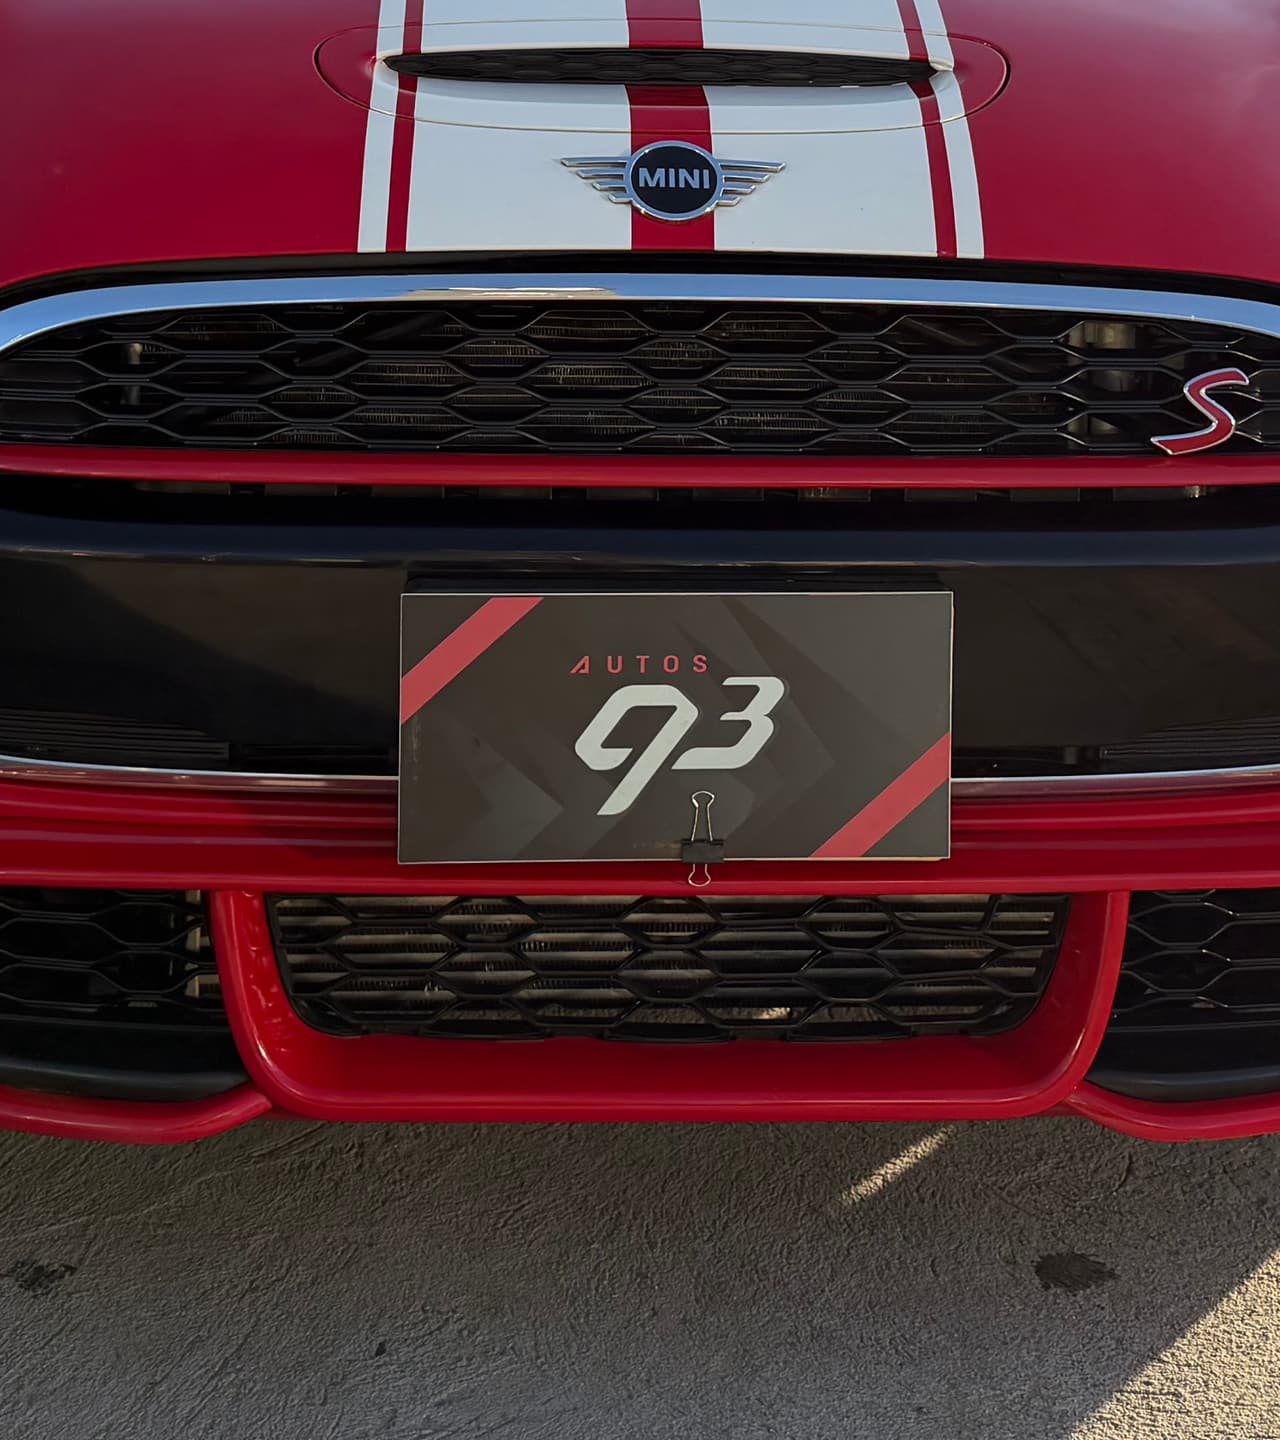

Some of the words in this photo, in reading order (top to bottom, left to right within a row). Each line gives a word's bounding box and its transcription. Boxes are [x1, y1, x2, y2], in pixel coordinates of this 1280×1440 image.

[638, 167, 711, 190] MINI
[1150, 367, 1250, 456] S
[570, 654, 709, 675] AUTOS
[574, 676, 786, 816] 93
